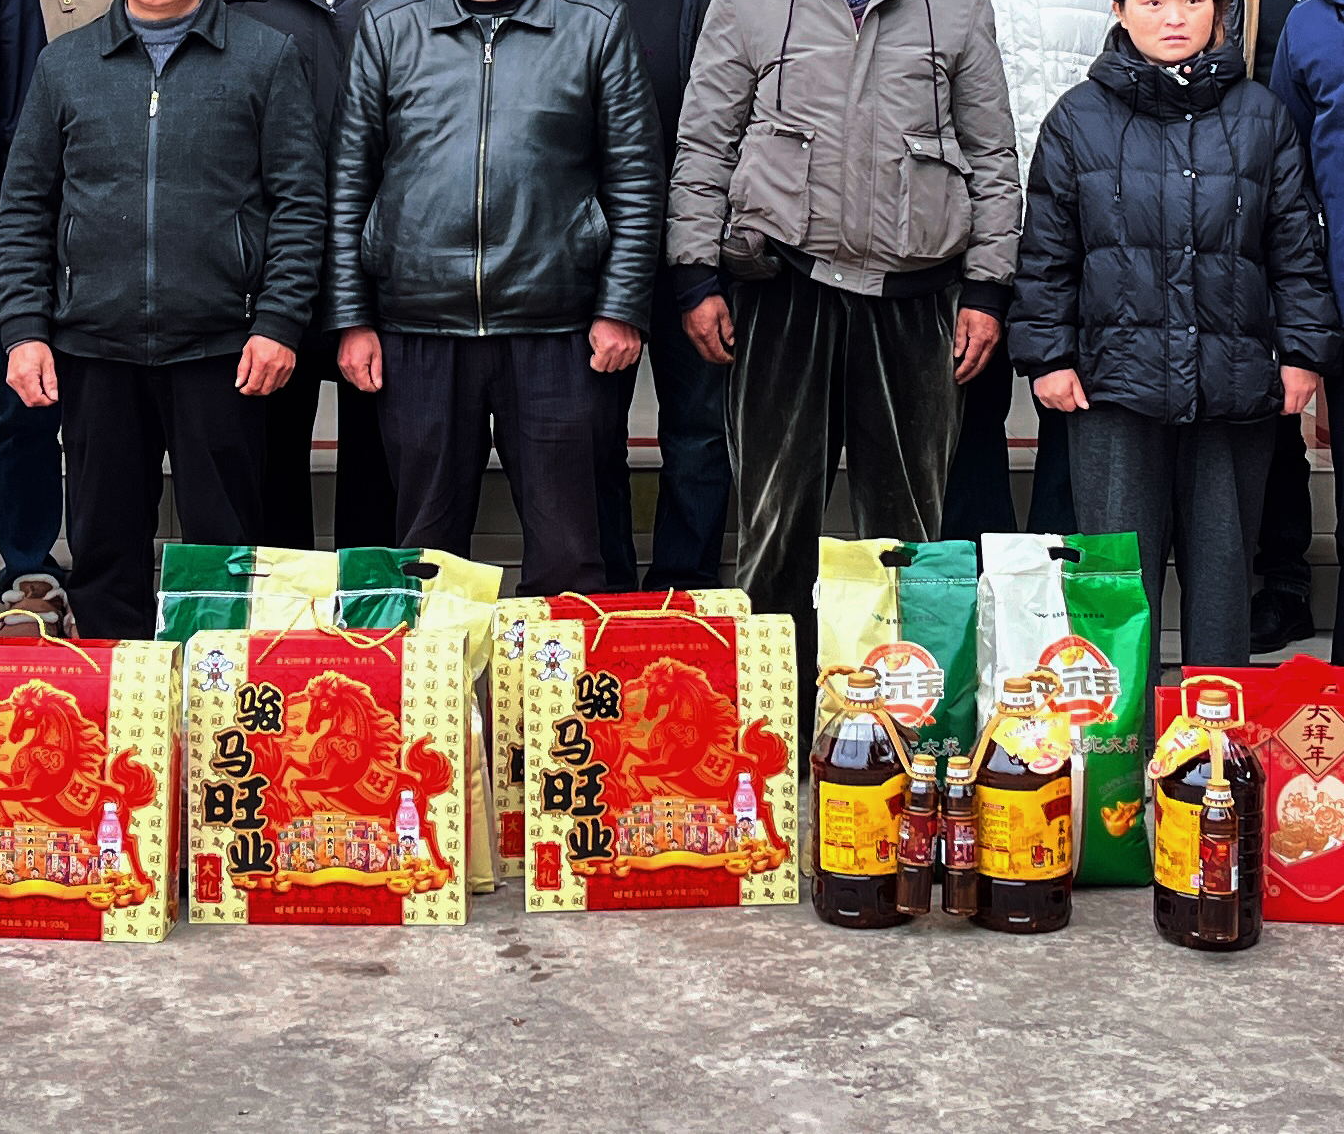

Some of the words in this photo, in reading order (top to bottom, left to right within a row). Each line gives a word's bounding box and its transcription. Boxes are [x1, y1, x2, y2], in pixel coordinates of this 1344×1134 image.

[542, 673, 621, 859] 骏马旺业
[1302, 706, 1334, 767] 大拜年
[203, 685, 283, 873] 骏马旺业
[200, 862, 219, 899] 大礼
[537, 847, 558, 885] 大礼
